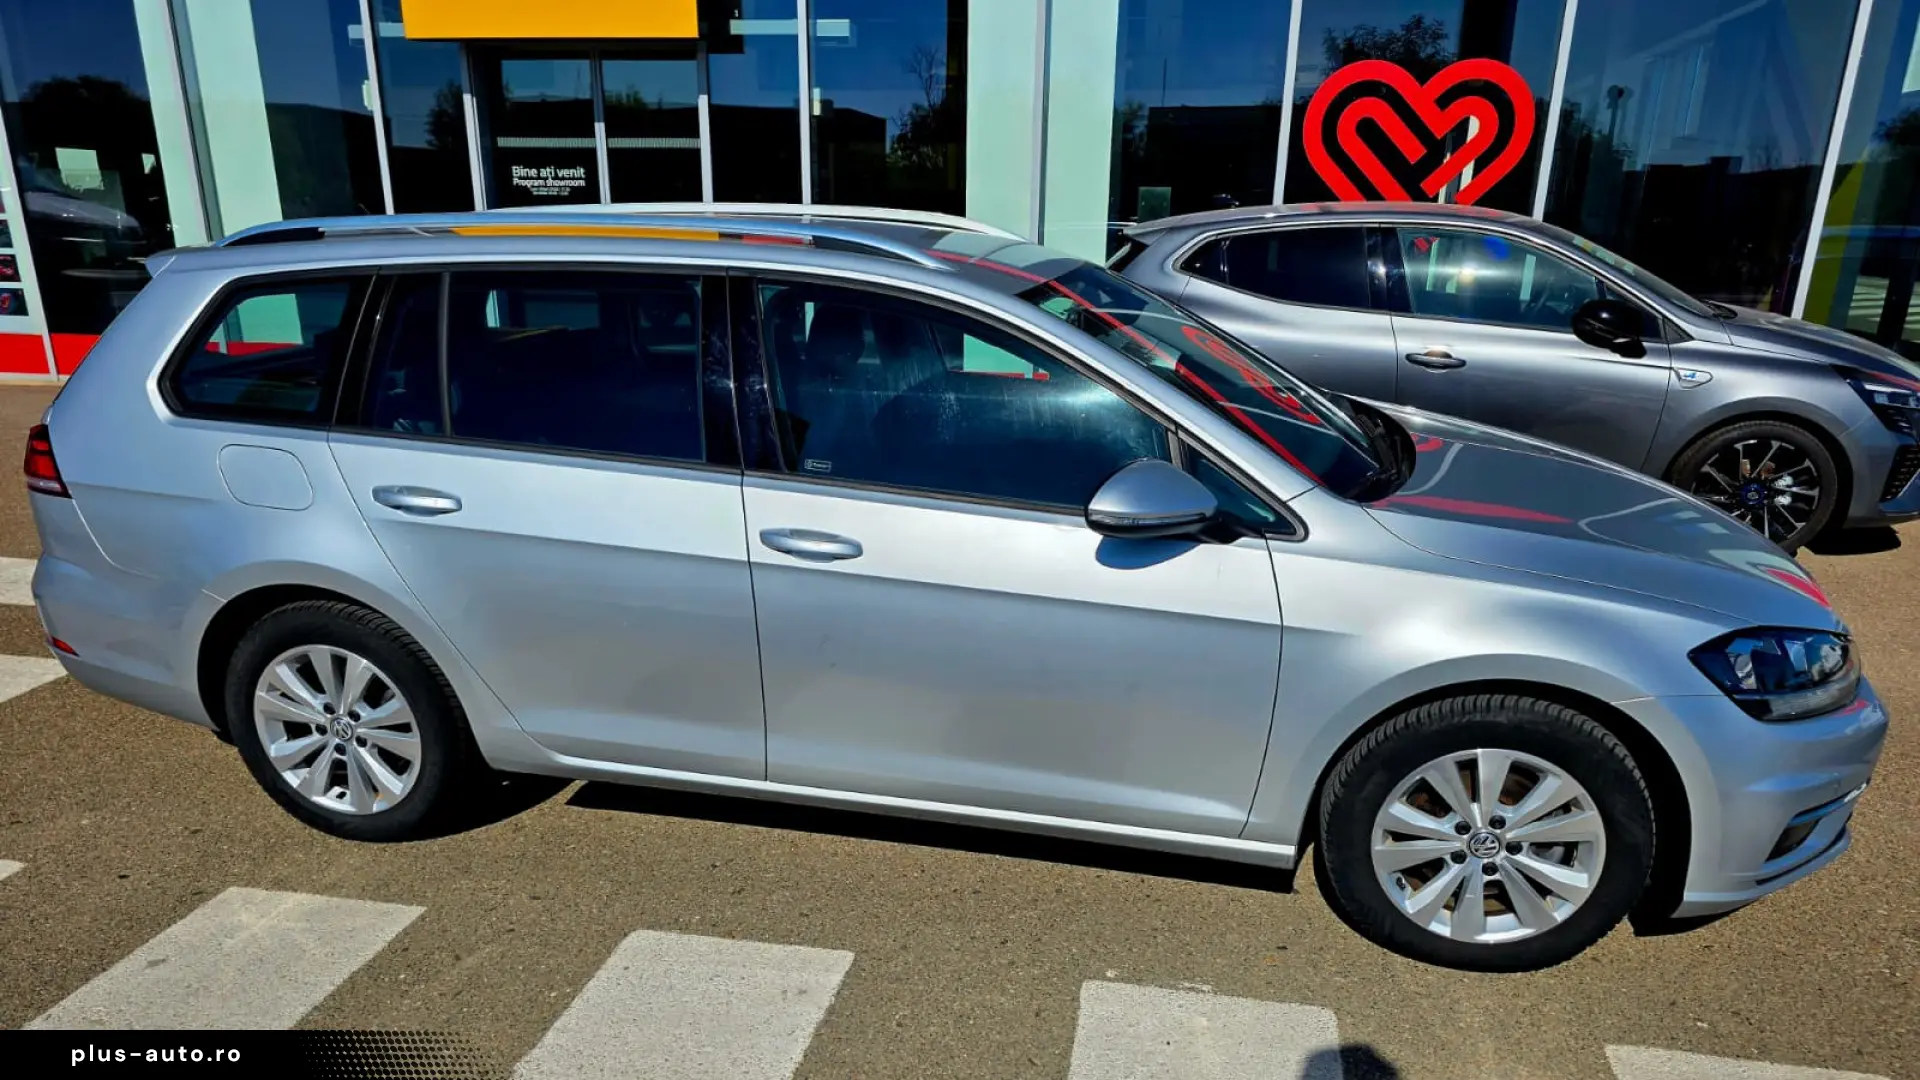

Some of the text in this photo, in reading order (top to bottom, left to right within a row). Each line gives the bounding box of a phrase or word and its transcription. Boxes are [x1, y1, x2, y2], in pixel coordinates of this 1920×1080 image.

[511, 165, 538, 177] Bine
[556, 166, 586, 178] venit
[512, 178, 586, 188] Program showroom
